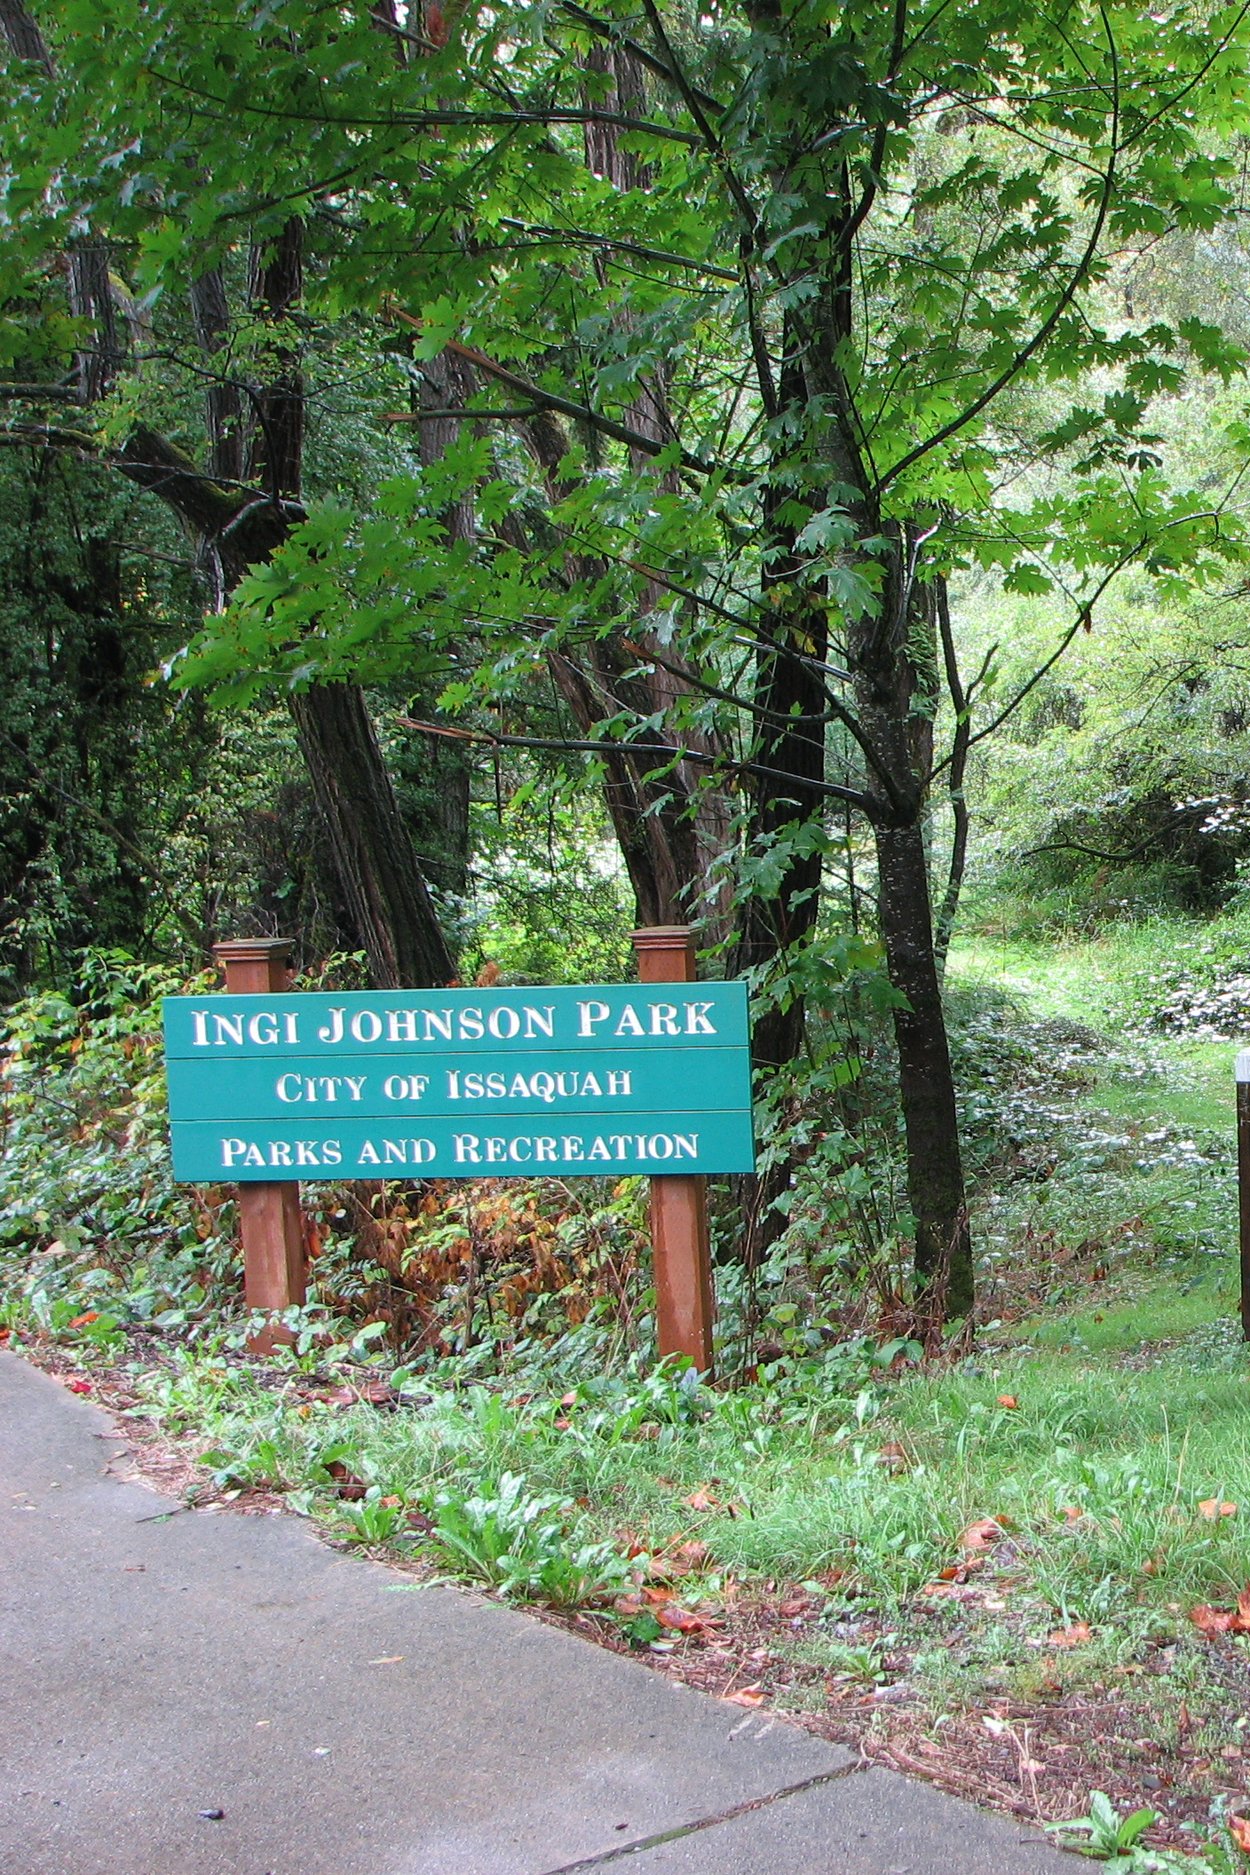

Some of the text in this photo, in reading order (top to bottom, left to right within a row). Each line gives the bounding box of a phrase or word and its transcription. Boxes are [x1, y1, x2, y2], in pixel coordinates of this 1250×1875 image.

[191, 1001, 717, 1046] INGI JOHNSON PARK
[276, 1069, 633, 1103] CITY OF ISSAQUAH
[221, 1132, 699, 1167] PARKS AND RECREATION
